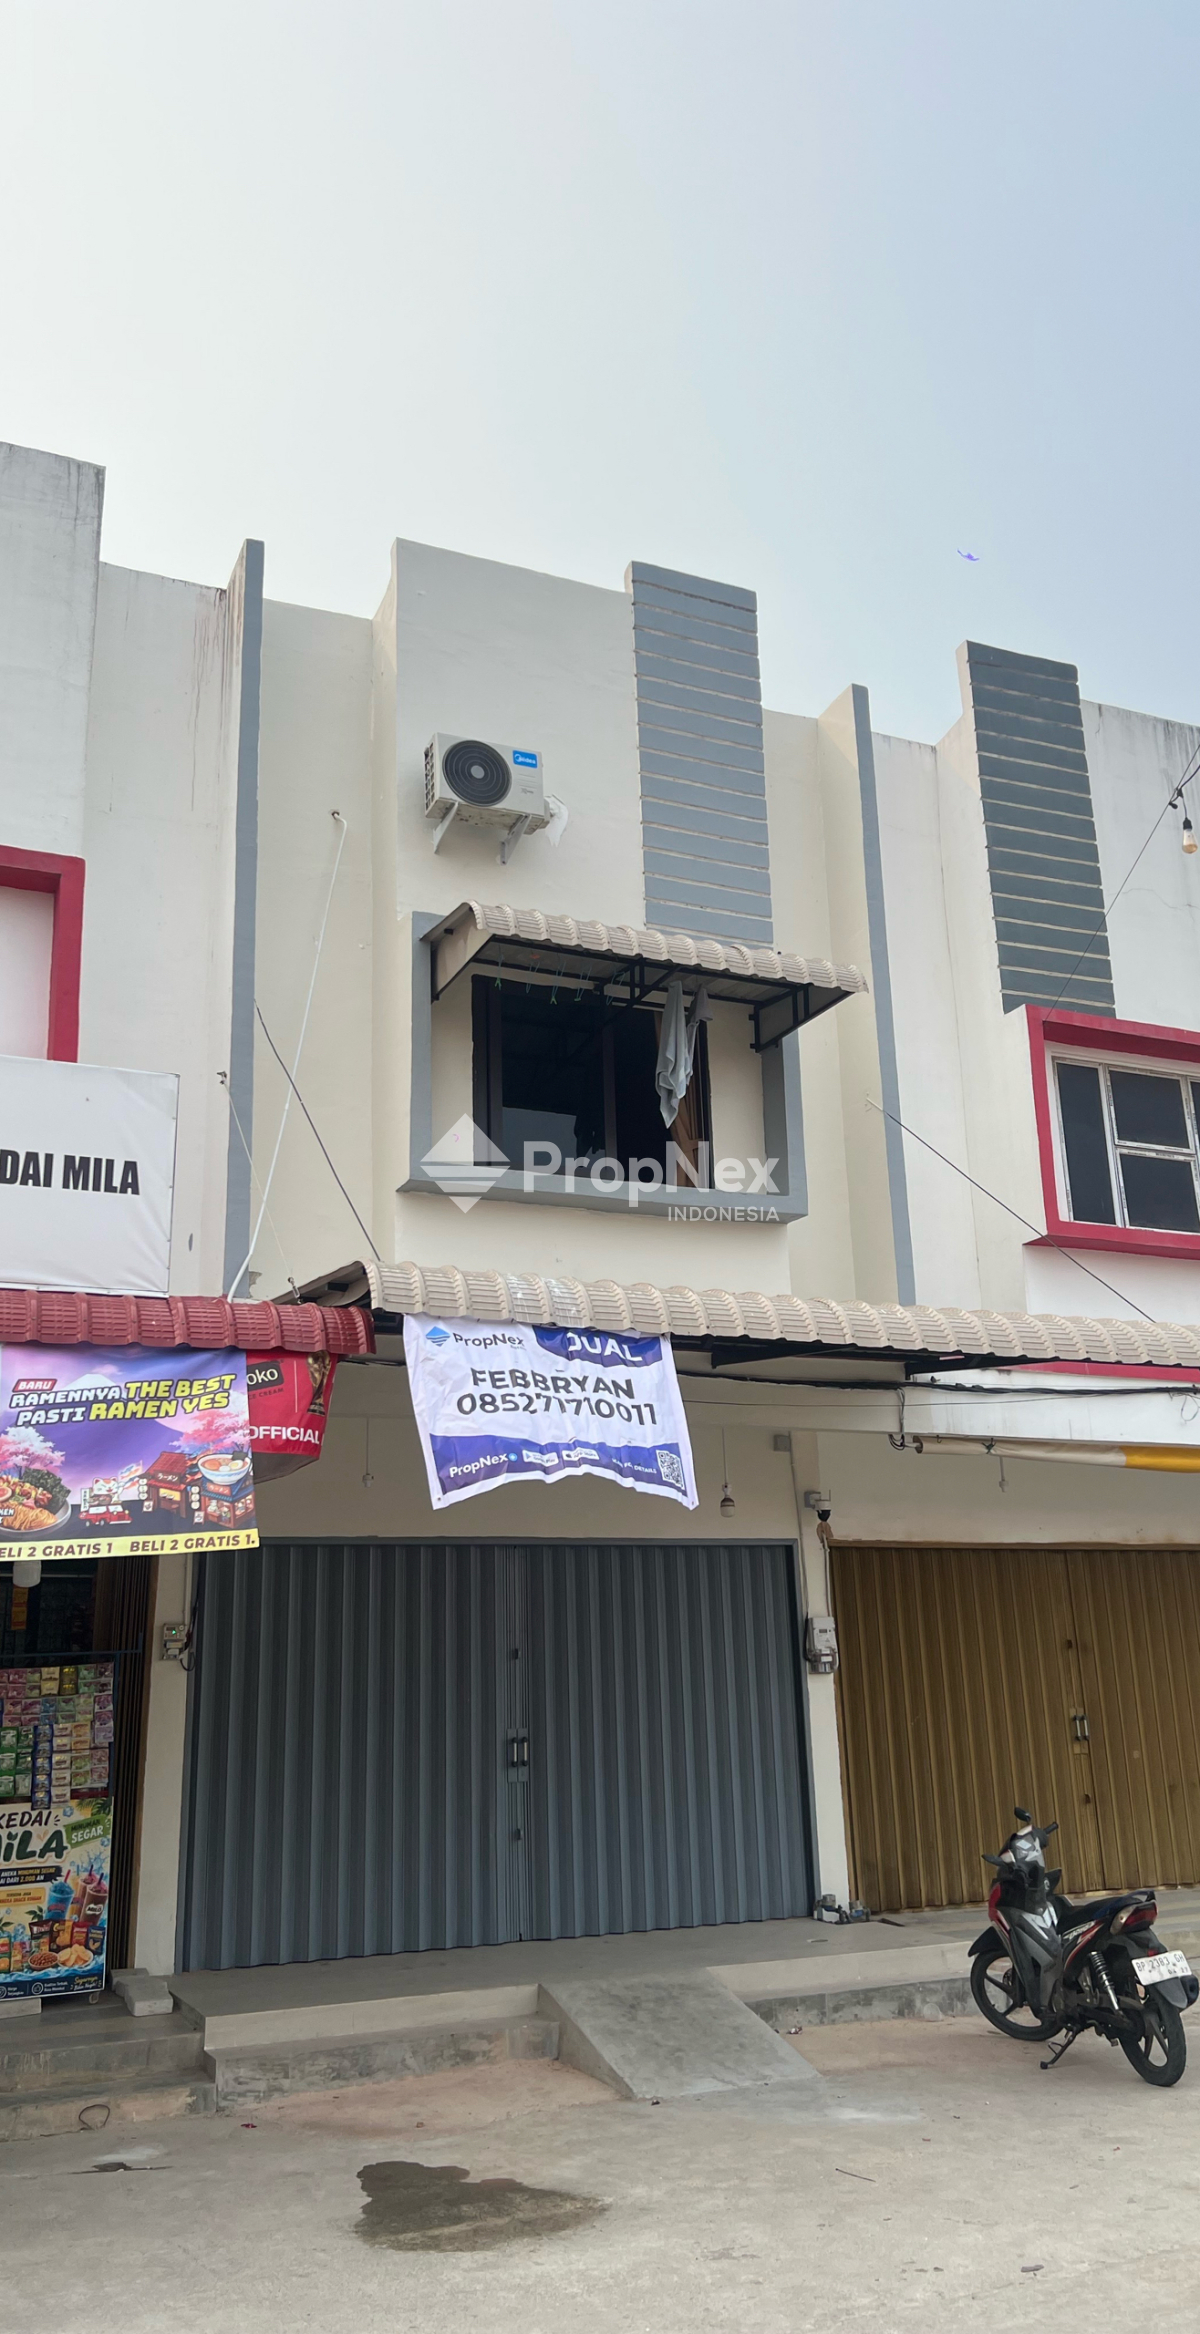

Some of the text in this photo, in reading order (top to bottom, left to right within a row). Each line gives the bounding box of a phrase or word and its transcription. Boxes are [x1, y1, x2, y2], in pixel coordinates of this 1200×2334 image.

[62, 1154, 140, 1195] MILA
[453, 1332, 525, 1350] PropNex
[10, 1374, 236, 1408] RAMENNYA THE BEST
[18, 1381, 52, 1390] BARU
[470, 1367, 636, 1400] FEBBRYAN
[16, 1392, 229, 1426] PASTI RAMEN YES
[250, 1426, 320, 1445] OFFICIAL
[449, 1453, 509, 1478] PropNex
[27, 1546, 37, 1557] 2
[42, 1543, 102, 1557] GRATIS
[106, 1542, 113, 1553] 1
[129, 1540, 166, 1552] BELI
[169, 1539, 179, 1551] 2
[184, 1535, 241, 1550] GRATIS
[71, 1825, 104, 1844] SEGAR
